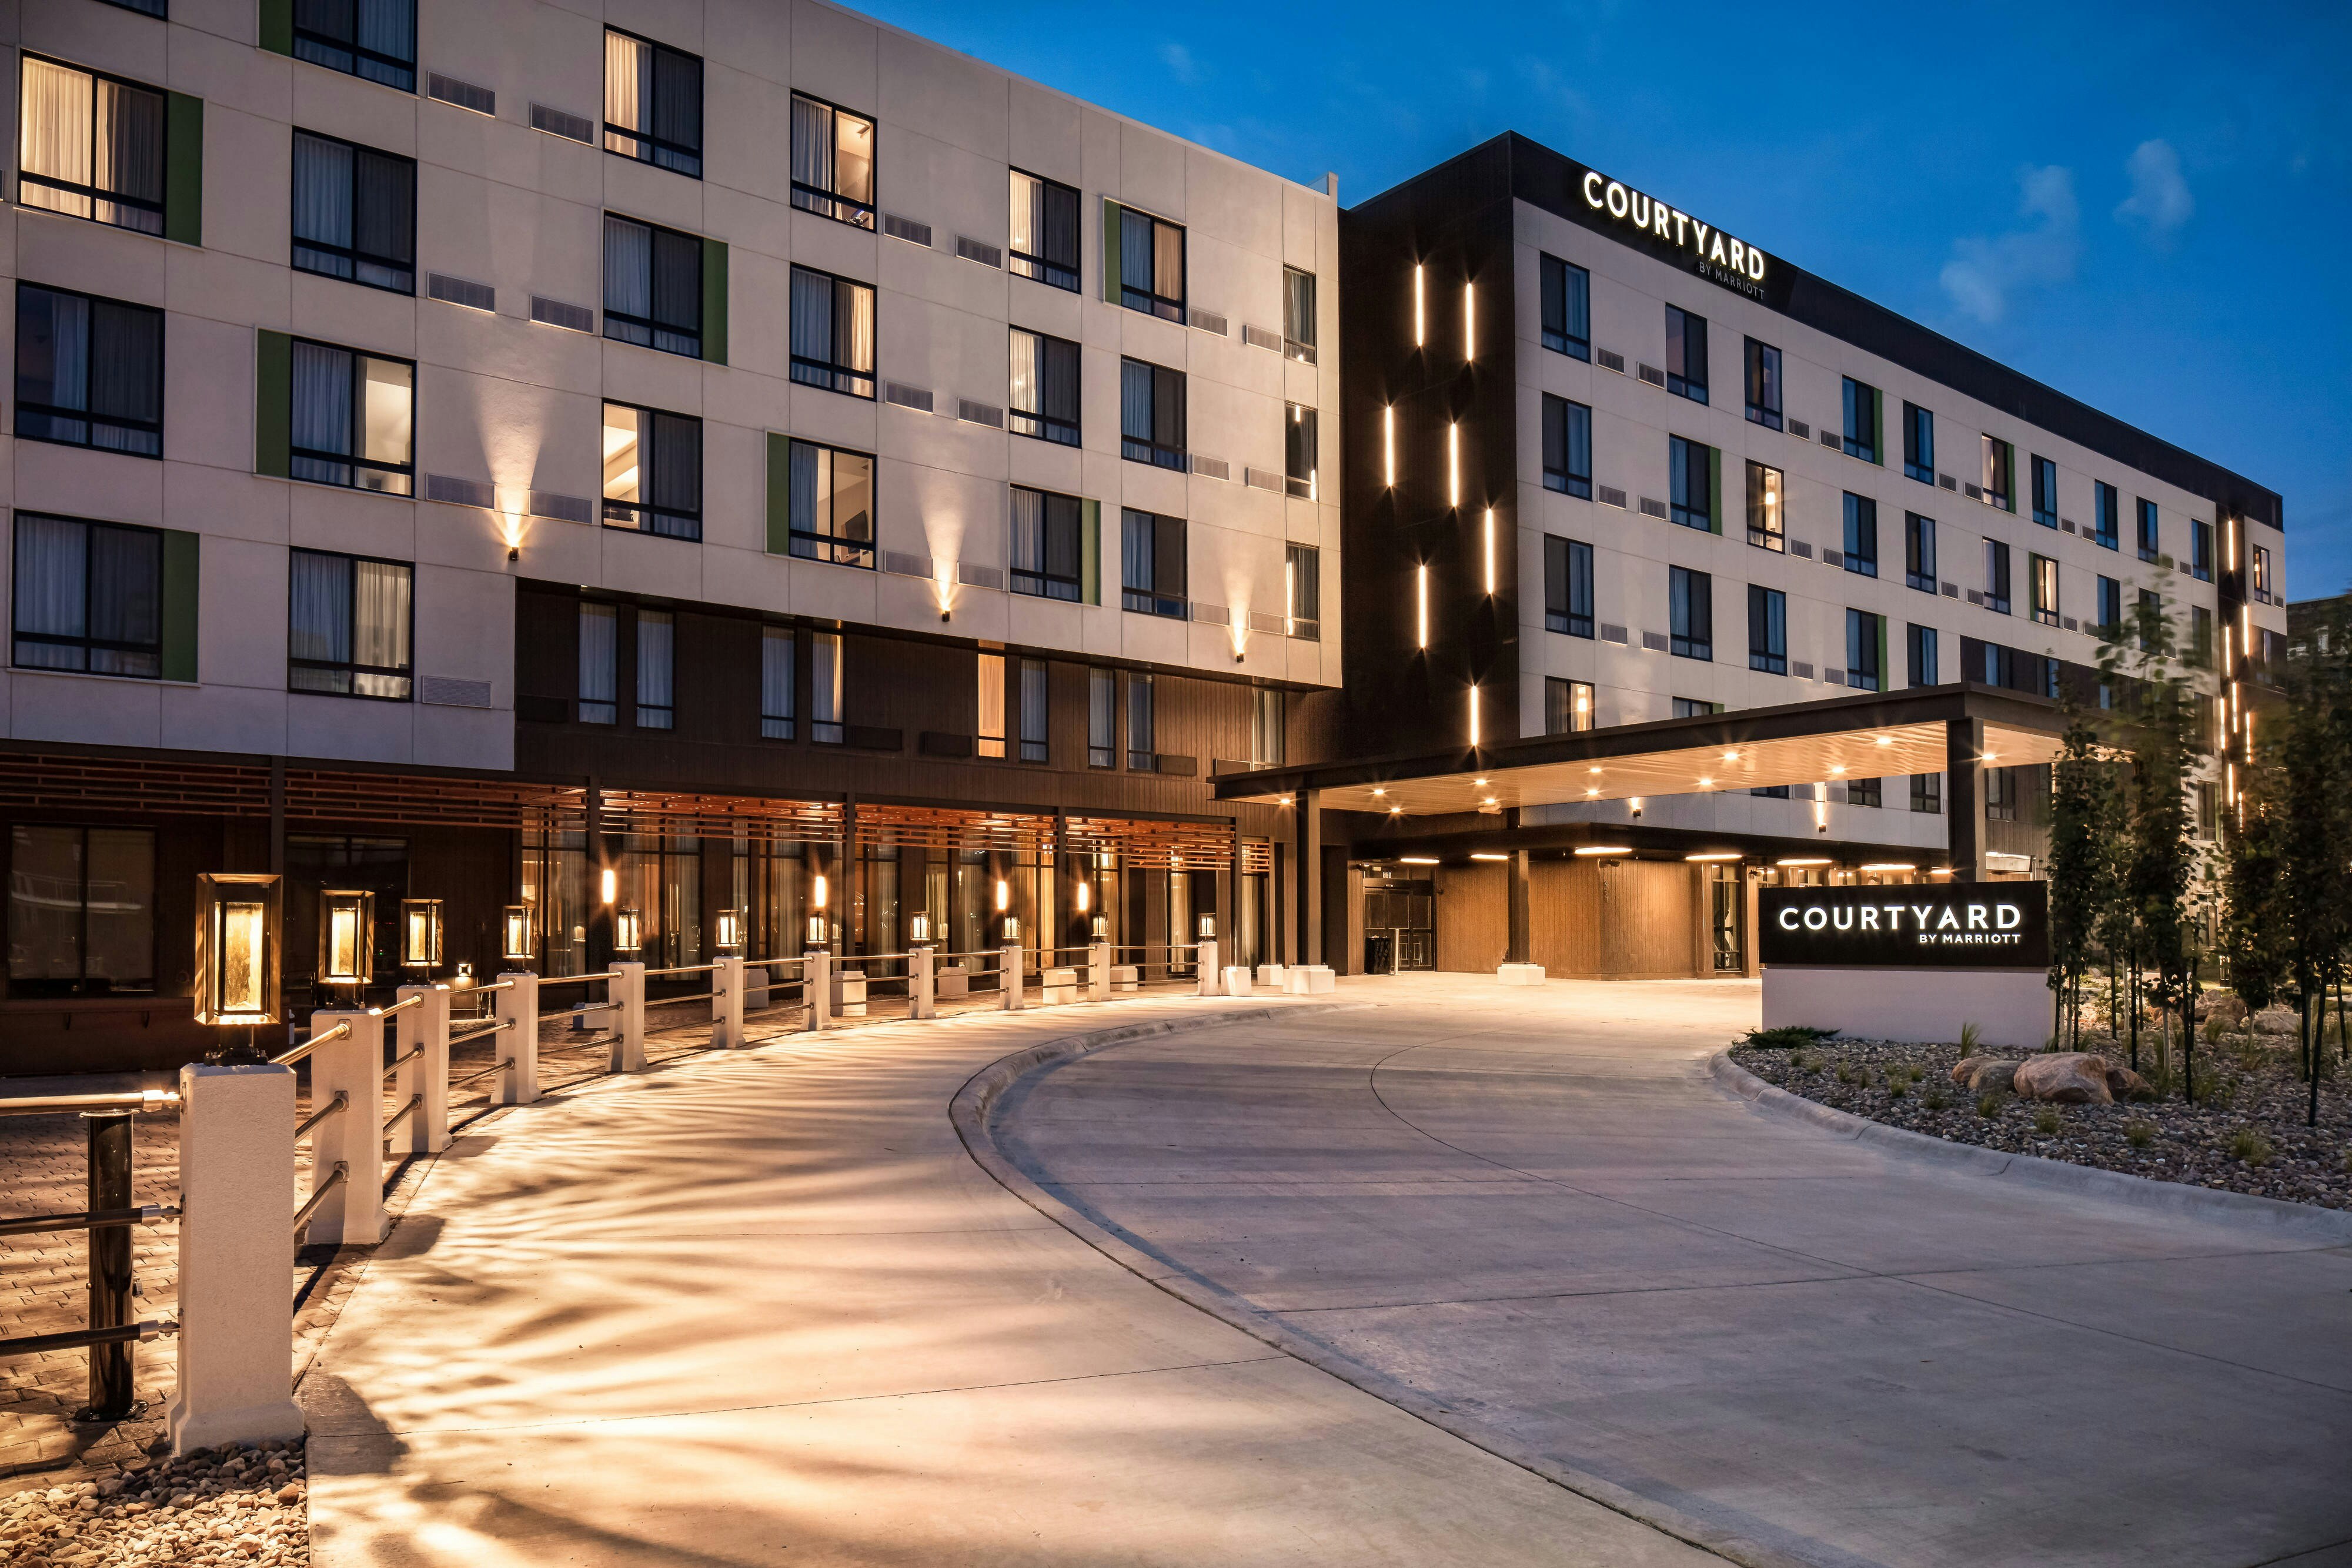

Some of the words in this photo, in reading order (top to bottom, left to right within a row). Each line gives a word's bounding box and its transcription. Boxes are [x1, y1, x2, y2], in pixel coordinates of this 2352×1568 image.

[1584, 172, 1764, 280] COURTYARD
[1699, 262, 1711, 275] BY
[1715, 269, 1764, 300] MARRIOTT
[1779, 904, 2021, 930] COURTYARD
[1919, 934, 1937, 943] BY
[1943, 934, 2020, 943] MARRIOTT
